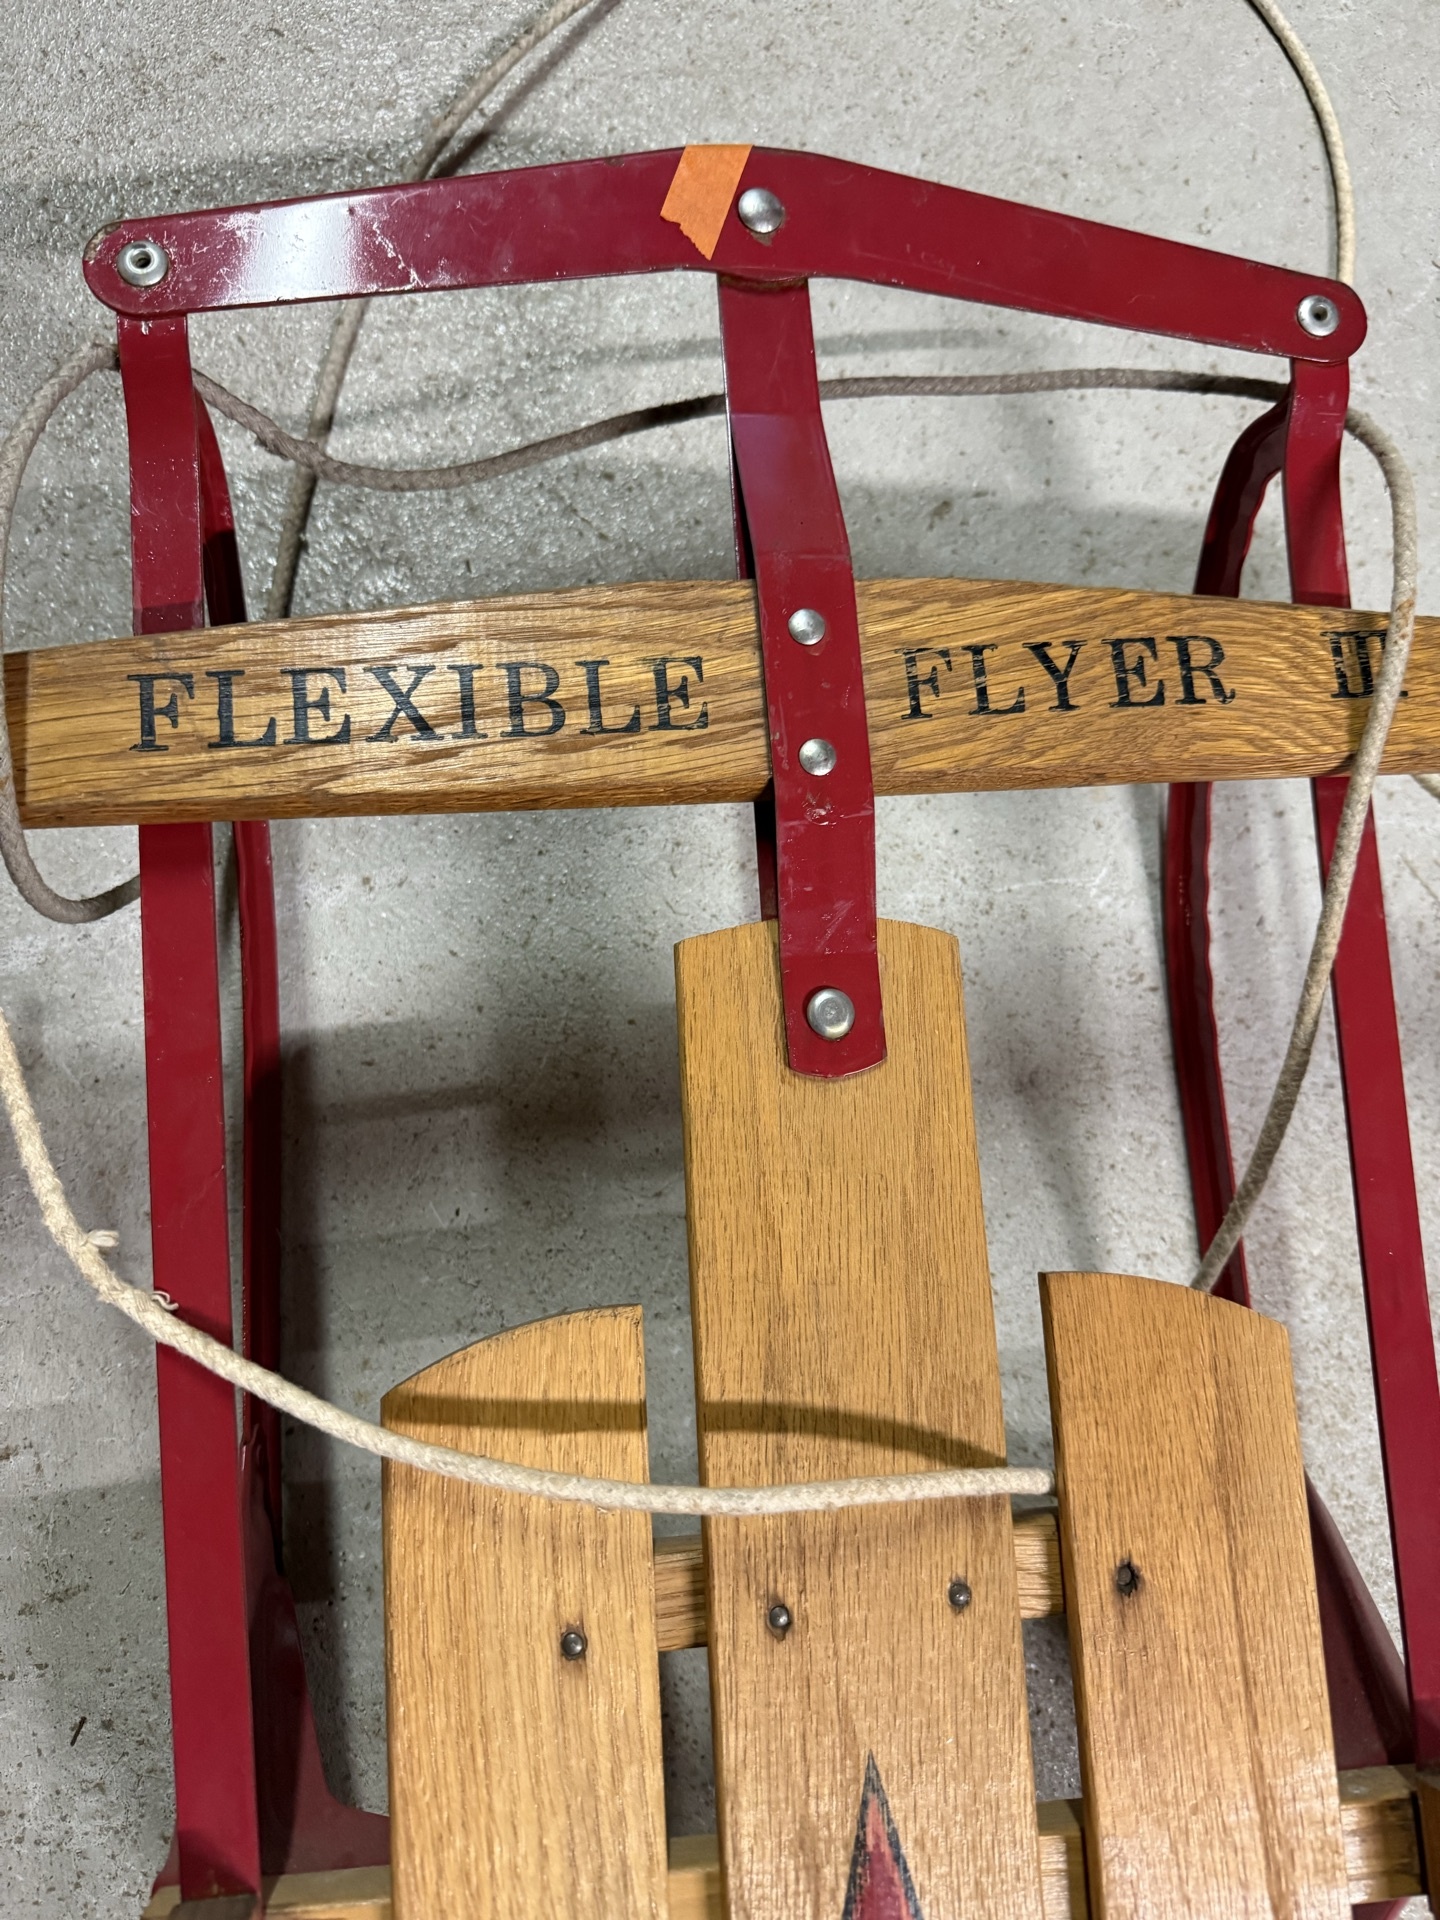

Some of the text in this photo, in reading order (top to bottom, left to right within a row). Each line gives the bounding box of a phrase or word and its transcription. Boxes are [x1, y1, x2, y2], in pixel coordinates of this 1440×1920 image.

[127, 630, 1409, 752] FLEXIBLE FLYER II
